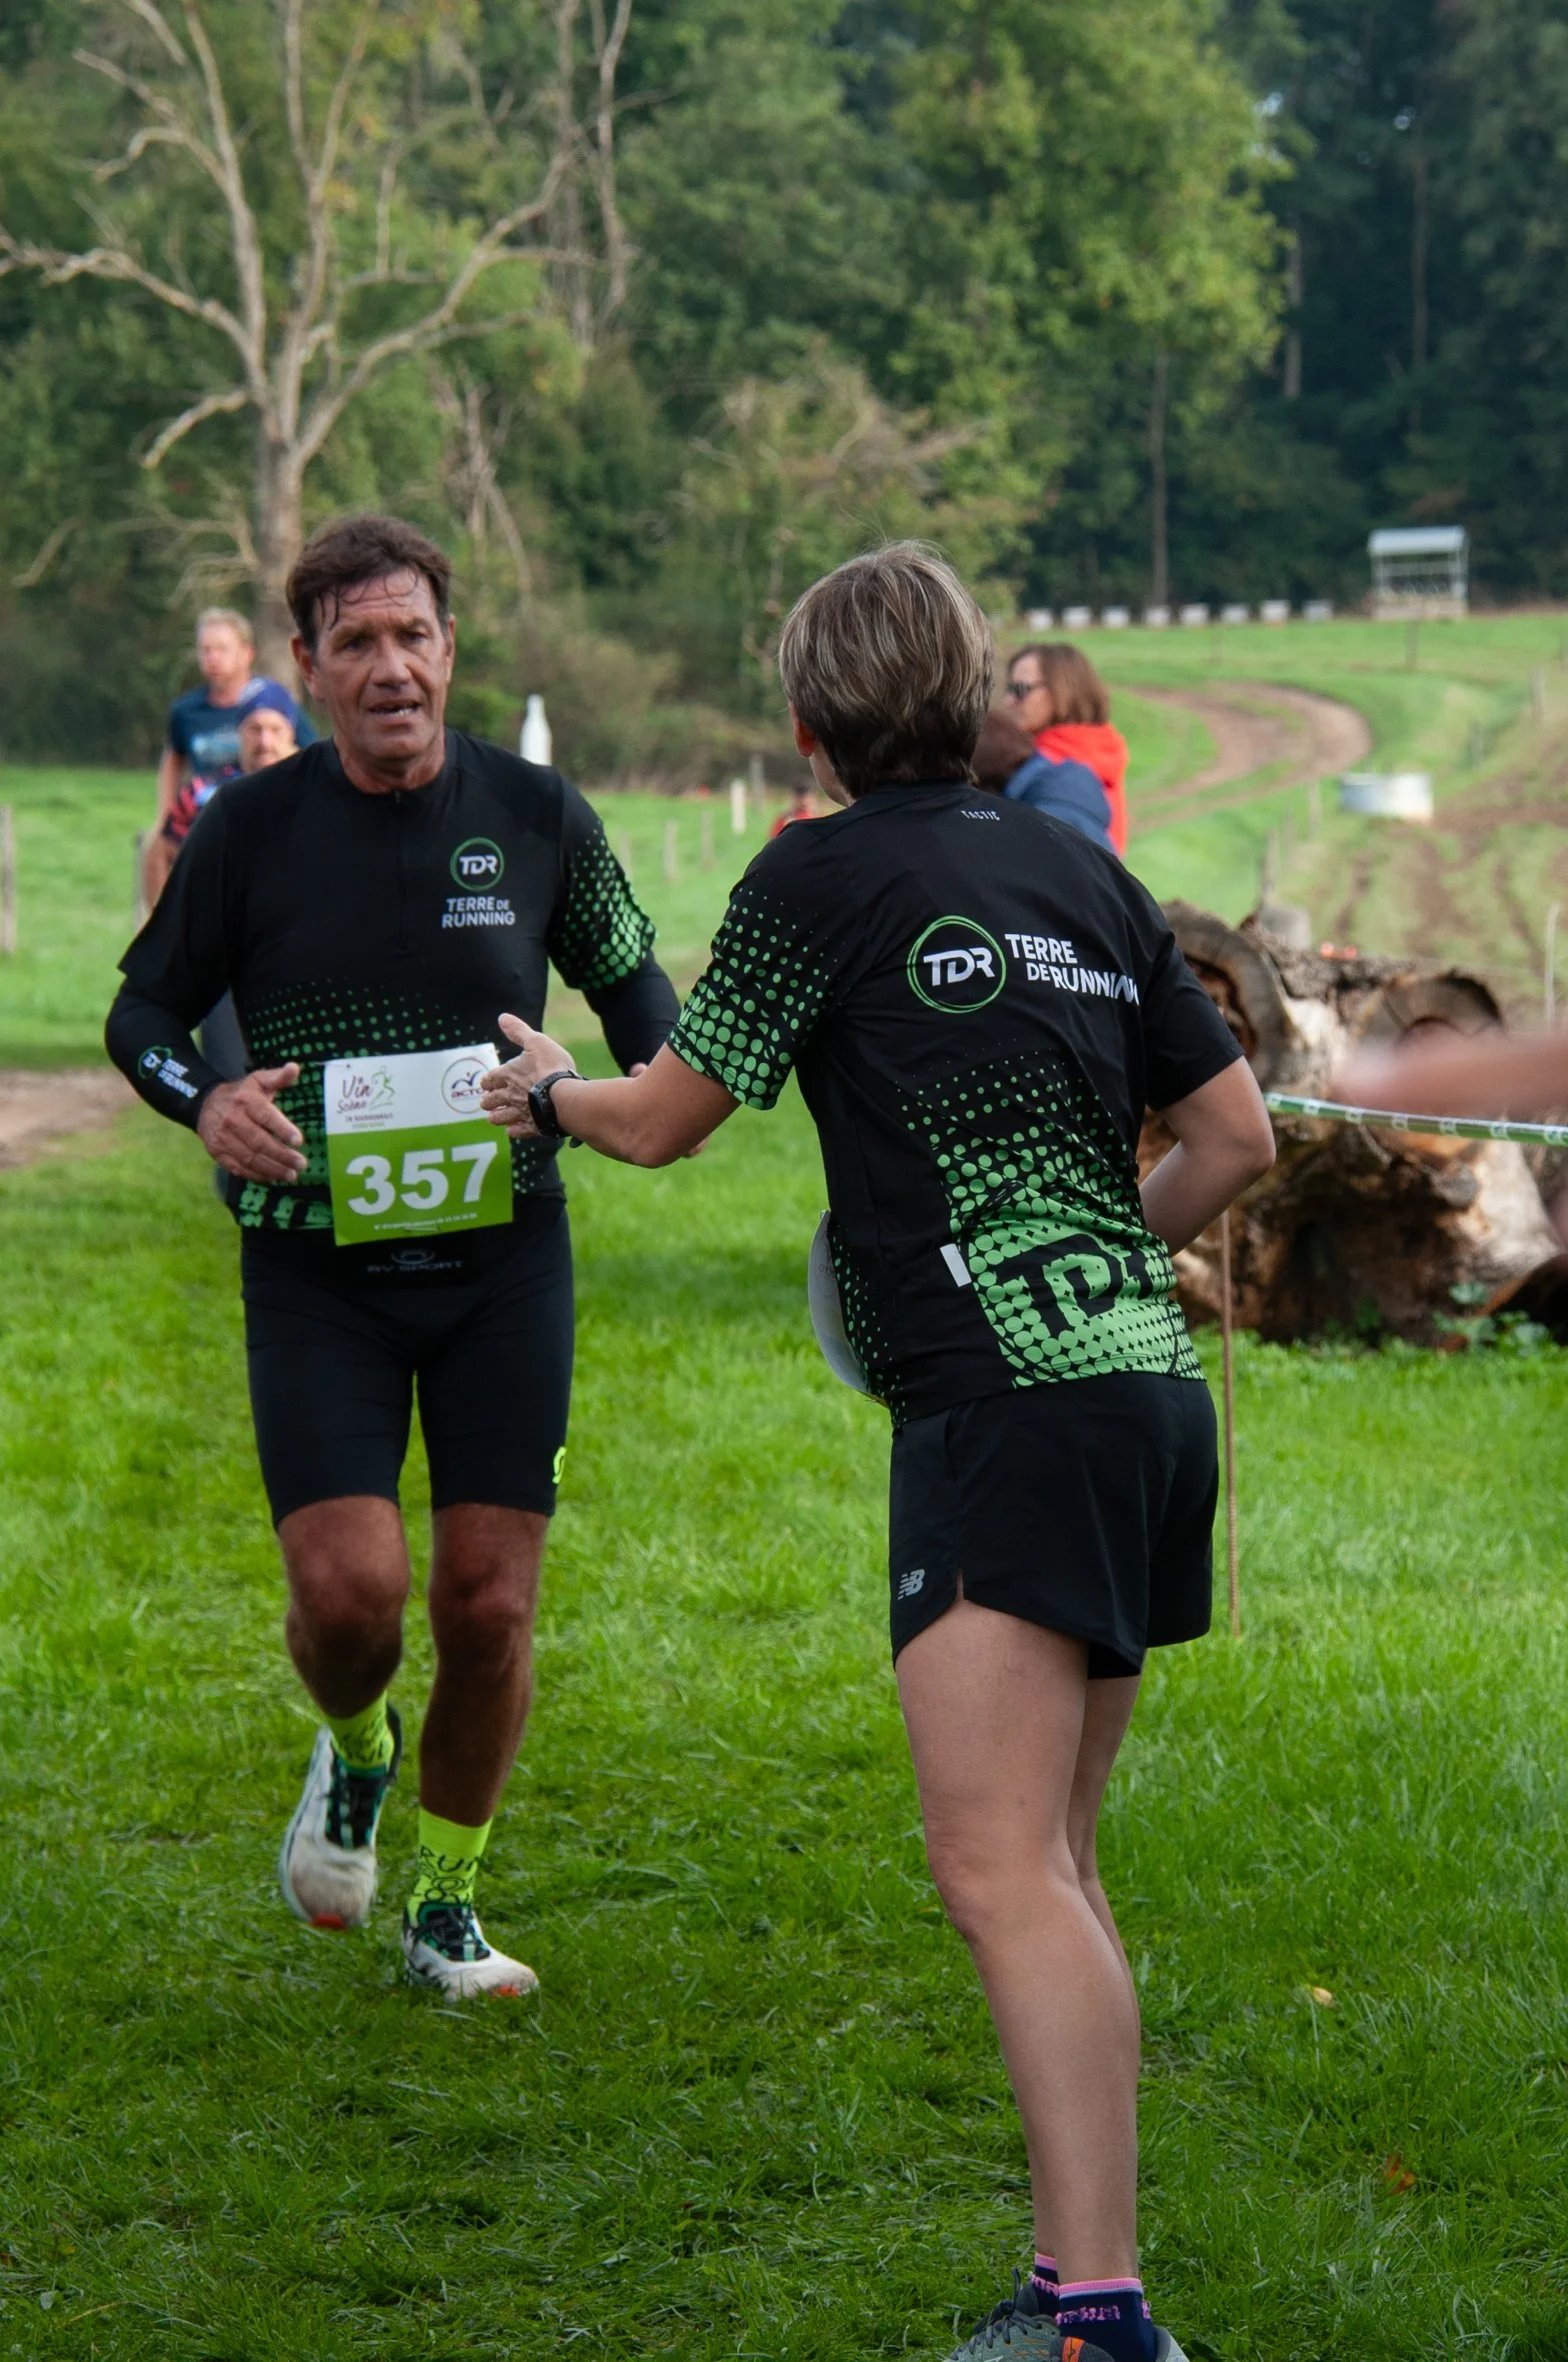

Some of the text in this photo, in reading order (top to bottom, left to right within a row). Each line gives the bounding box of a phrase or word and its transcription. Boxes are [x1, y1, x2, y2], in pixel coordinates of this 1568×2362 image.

[459, 855, 498, 875] TDR
[446, 896, 510, 913] TERRE DE
[441, 911, 516, 928] RUNNING
[1004, 933, 1078, 964] TERRE
[923, 947, 996, 987] TDR
[1026, 962, 1051, 981] DE
[346, 1141, 498, 1216] 357
